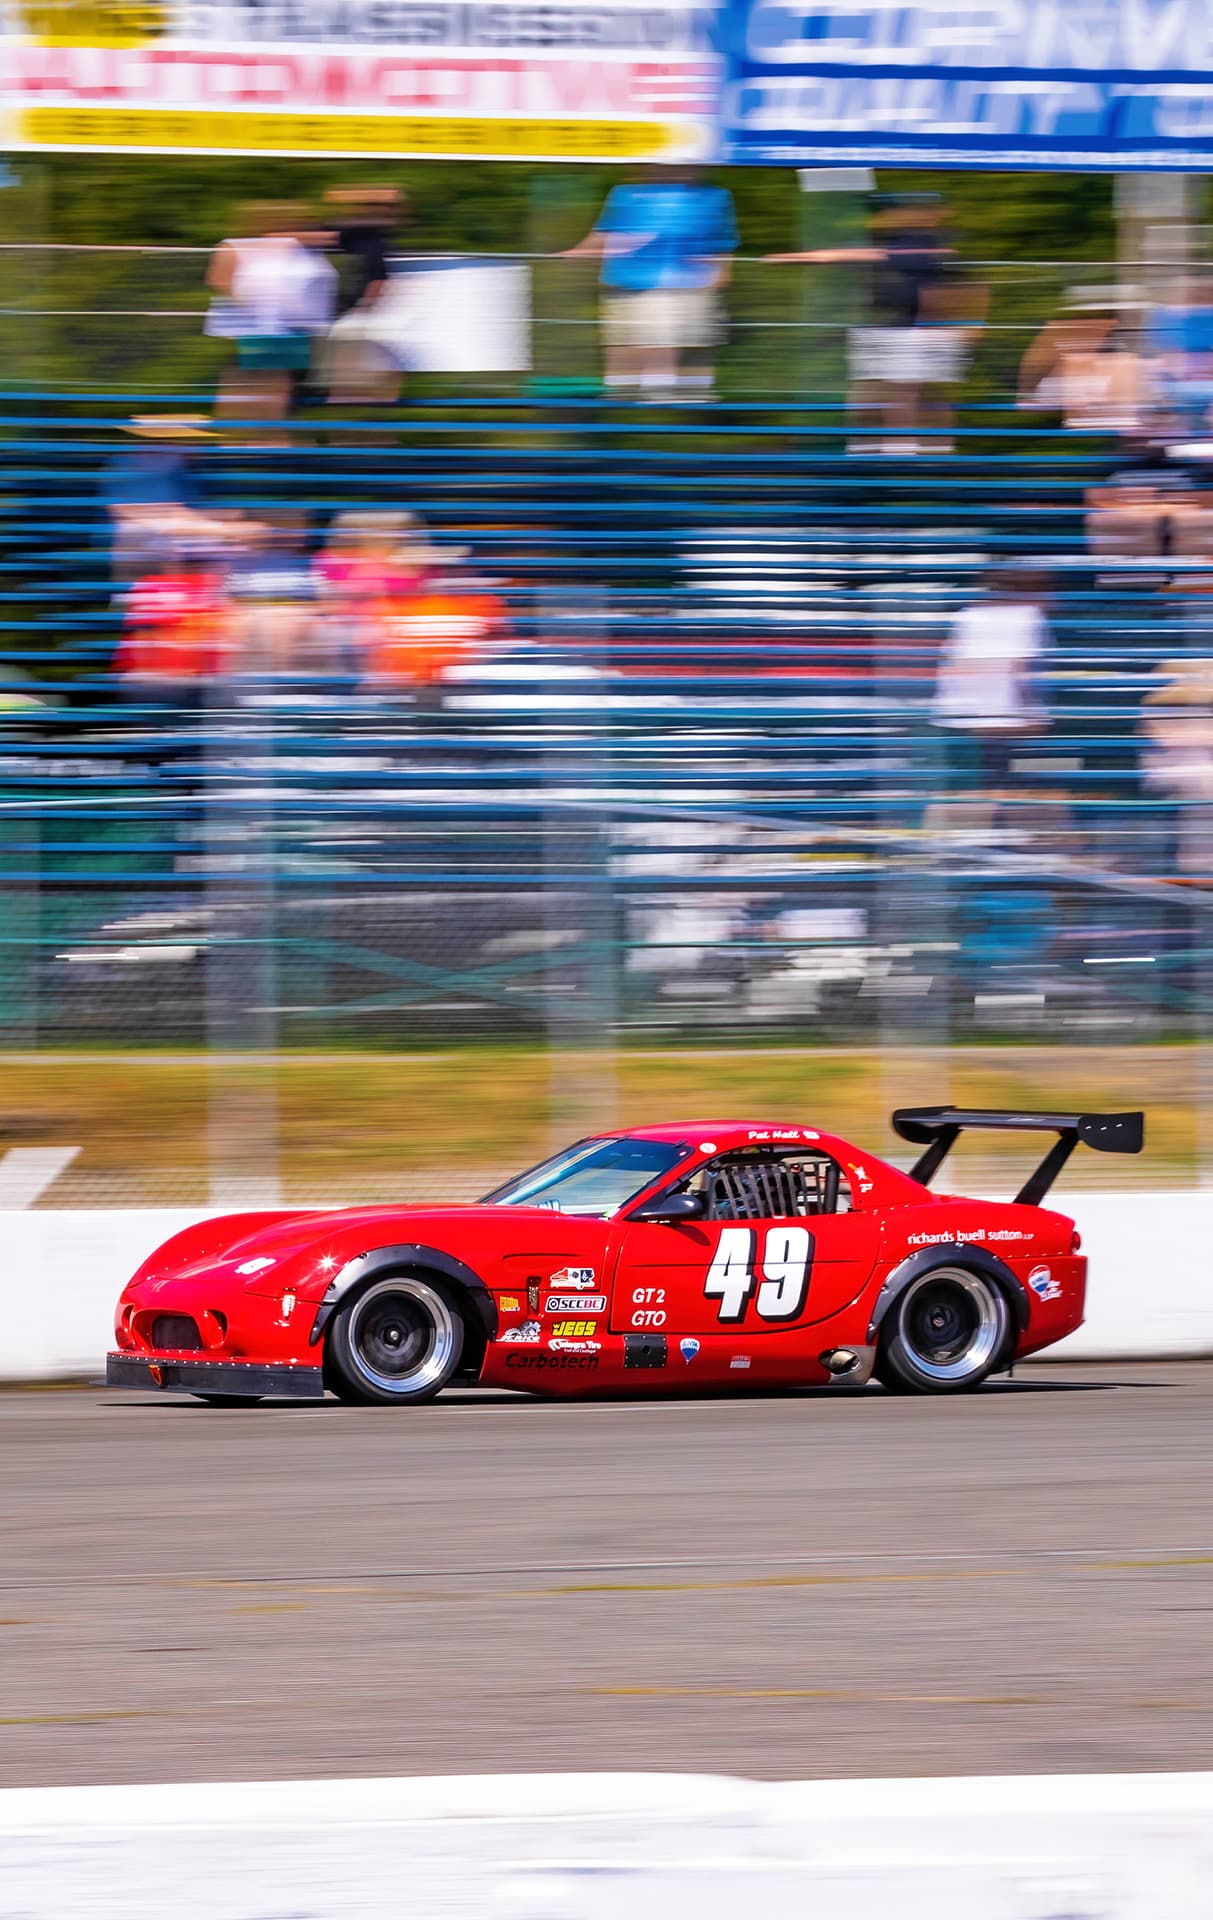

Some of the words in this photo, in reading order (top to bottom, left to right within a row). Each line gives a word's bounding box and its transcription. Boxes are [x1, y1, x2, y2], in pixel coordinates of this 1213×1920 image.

[748, 1131, 770, 1139] Pat
[773, 1131, 800, 1139] Hall
[908, 1231, 954, 1244] richards
[956, 1229, 985, 1241] buell
[988, 1230, 1022, 1240] sutton
[703, 1227, 815, 1324] 49
[632, 1288, 656, 1303] GT
[560, 1300, 600, 1309] SCCBC
[631, 1310, 667, 1326] GTO
[552, 1321, 596, 1336] JEGS
[505, 1353, 600, 1369] Carbotech
